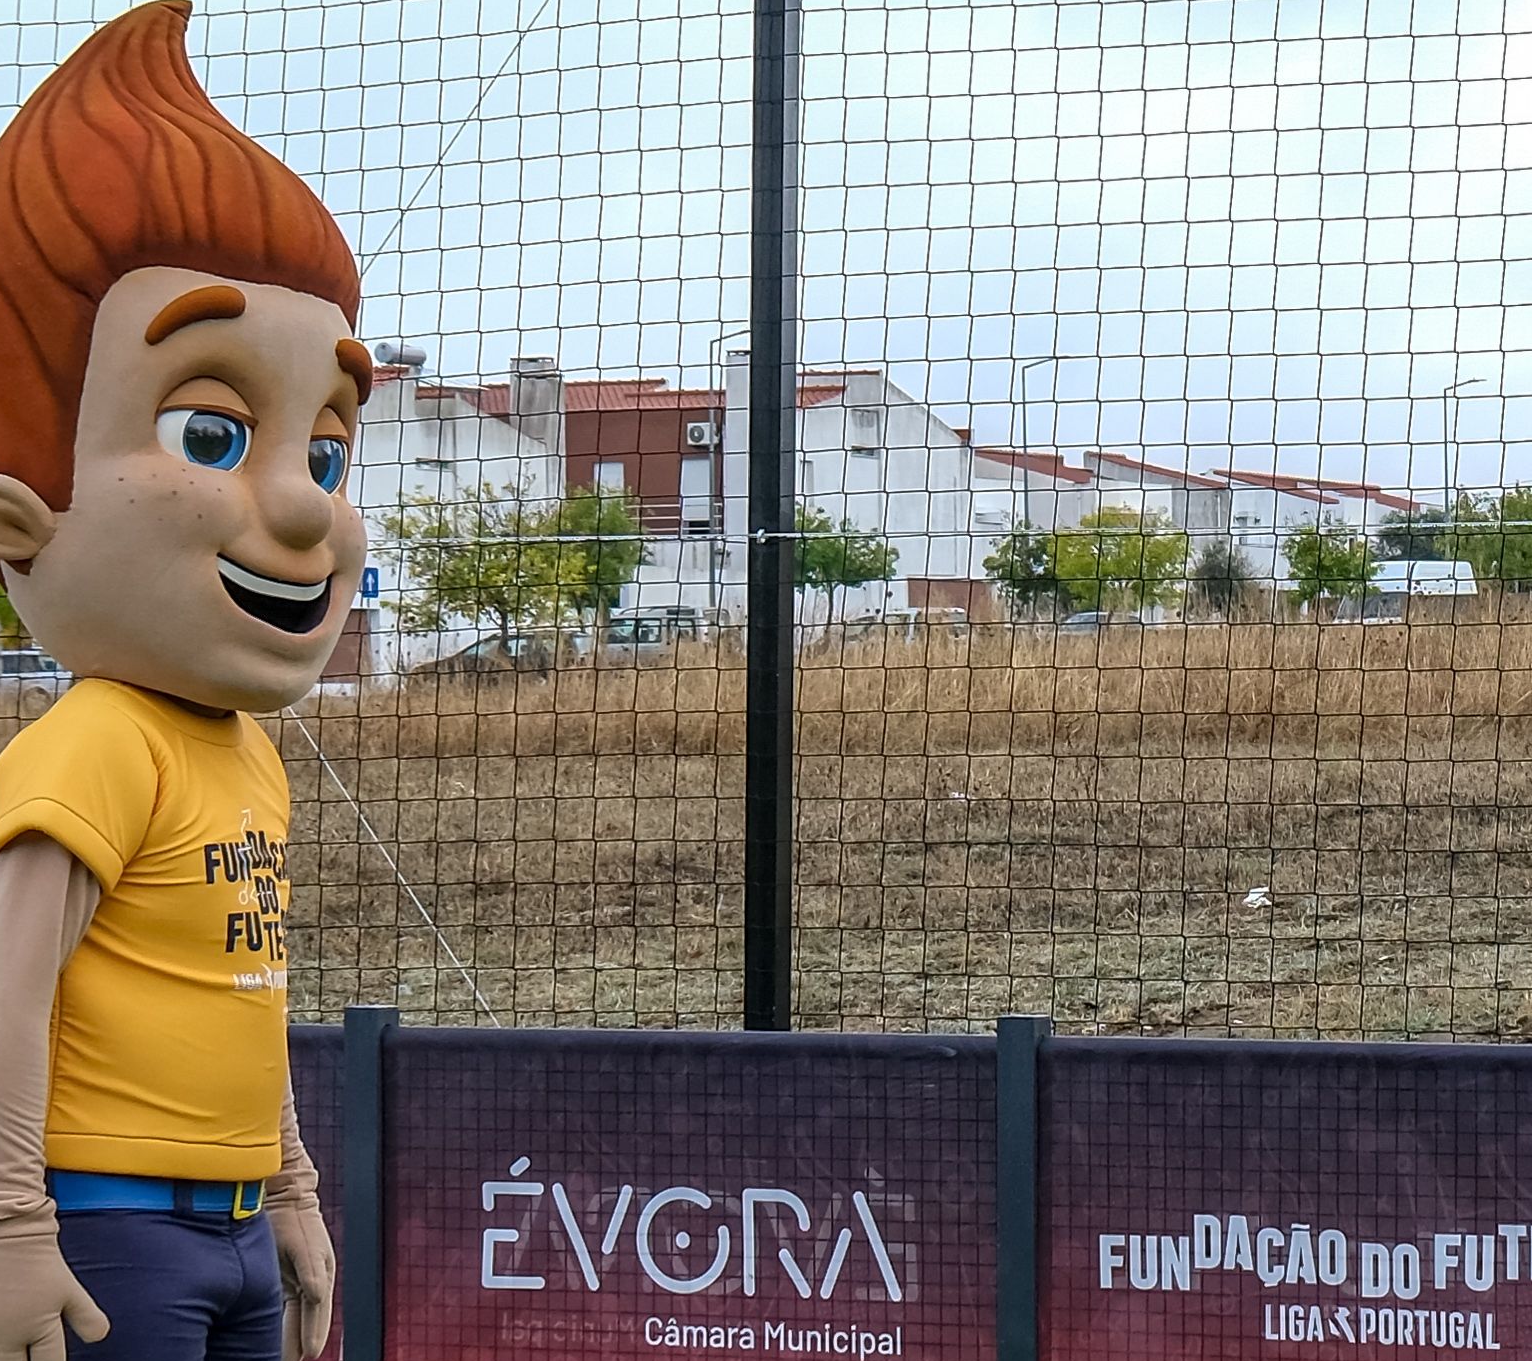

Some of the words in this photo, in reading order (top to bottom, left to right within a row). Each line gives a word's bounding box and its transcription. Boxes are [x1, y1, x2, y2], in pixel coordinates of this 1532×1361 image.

[481, 1156, 903, 1303] ÉVORA
[1099, 1214, 1348, 1292] FUNDAÇÃO
[1361, 1242, 1421, 1300] DO
[645, 1317, 755, 1350] Câmara
[764, 1321, 902, 1361] Municipal
[1265, 1303, 1325, 1342] LIGA
[1359, 1307, 1501, 1350] PORTUGAL
